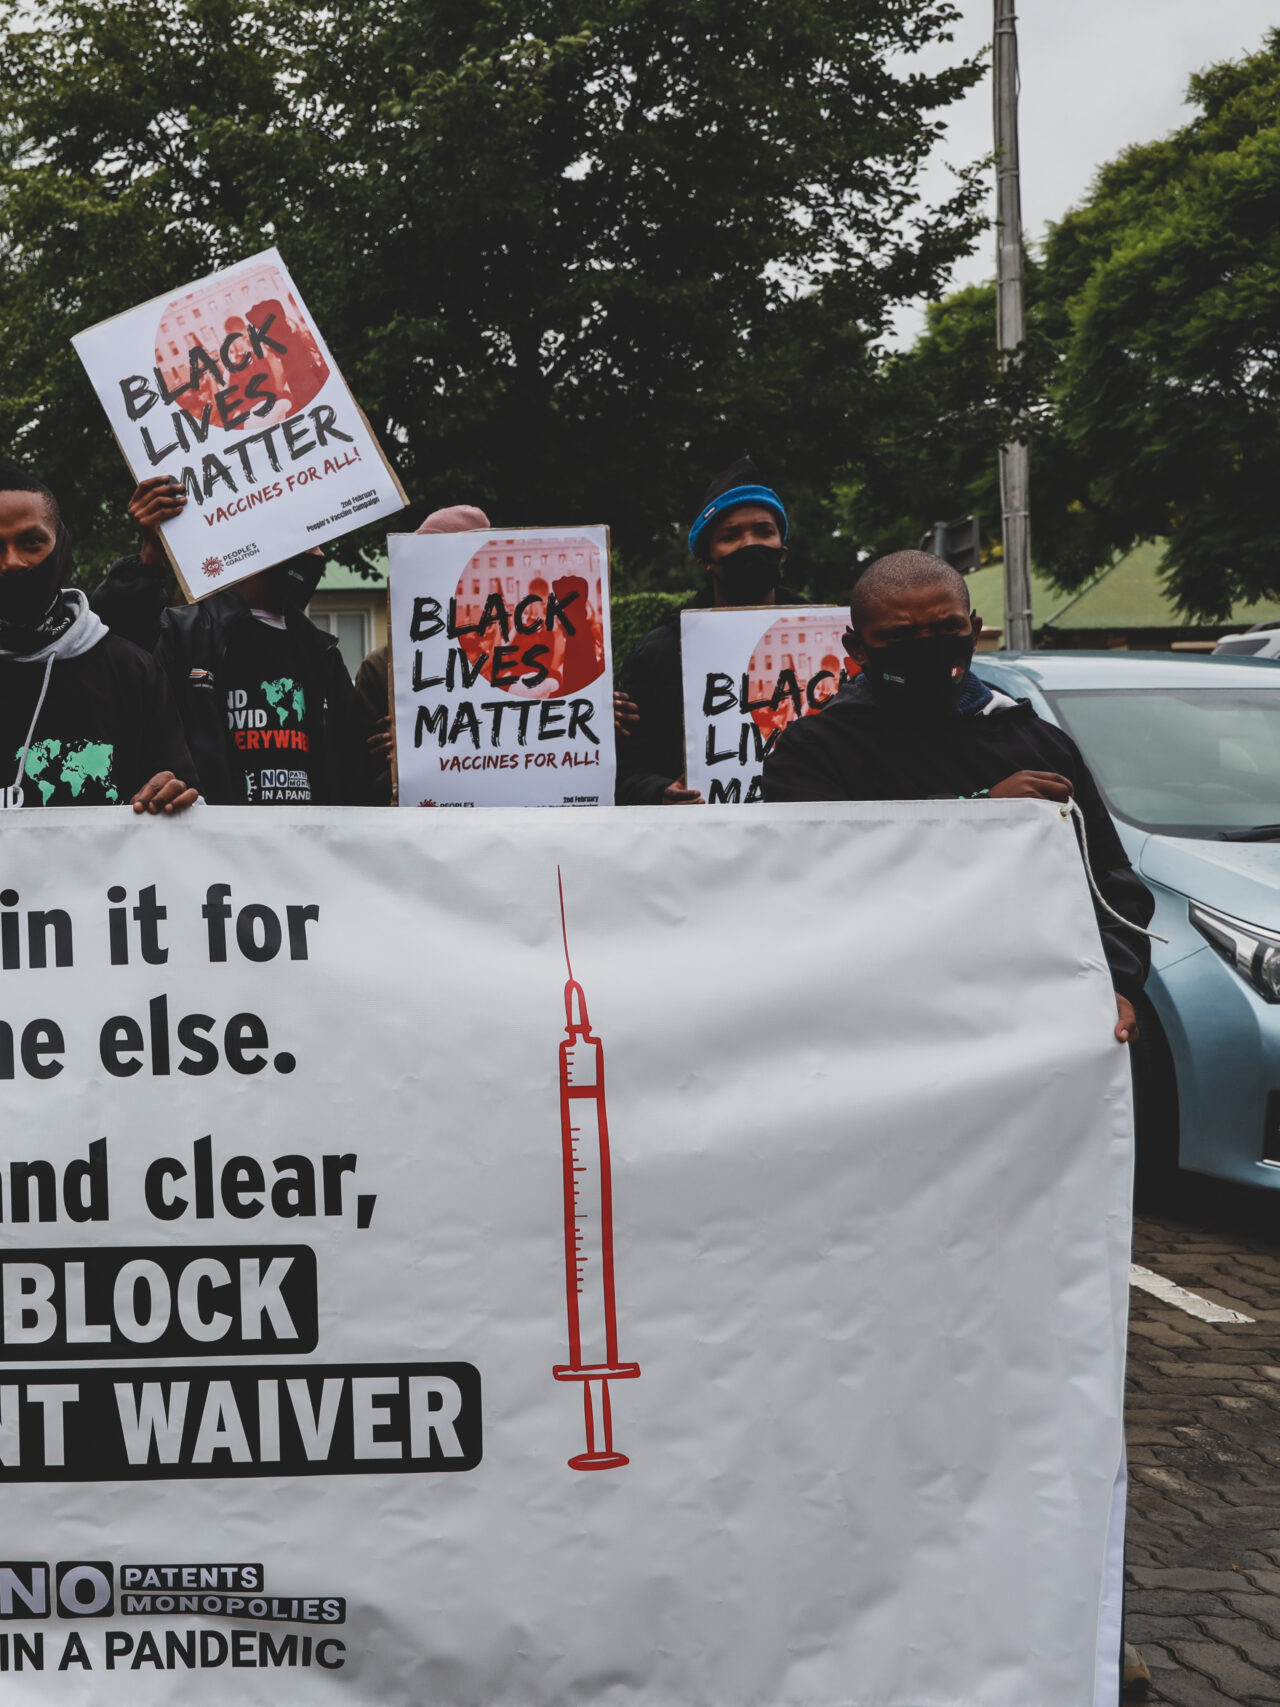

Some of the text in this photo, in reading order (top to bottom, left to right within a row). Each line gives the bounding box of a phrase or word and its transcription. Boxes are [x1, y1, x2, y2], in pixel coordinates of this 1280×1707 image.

[119, 313, 287, 422] BLACK
[140, 373, 276, 466] LIVES
[203, 446, 362, 527] VACCINES FOR ALL!
[352, 489, 377, 504] February
[306, 496, 380, 532] People's Vaccine Campaign
[223, 542, 257, 561] PEOPLE'S
[225, 548, 260, 566] COALITION
[410, 591, 580, 643] BLACK
[412, 644, 550, 692] LIVES
[703, 669, 848, 718] BLAC
[414, 699, 600, 750] MATTER
[705, 722, 783, 766] LIV
[261, 770, 288, 787] NO
[440, 749, 600, 773] VACCINES FOR ALL!
[261, 789, 311, 800] IN A PAND
[575, 795, 599, 803] February
[107, 884, 169, 966] it
[201, 883, 320, 963] for
[99, 993, 297, 1077] else.
[144, 1134, 378, 1230] clear,
[1, 1254, 300, 1346] BLOCK
[112, 1374, 466, 1466] WAIVER
[125, 1566, 258, 1590] PATENTS
[126, 1594, 341, 1622] MONOPOLIES
[0, 1630, 346, 1672] IN A PANDEMIC
